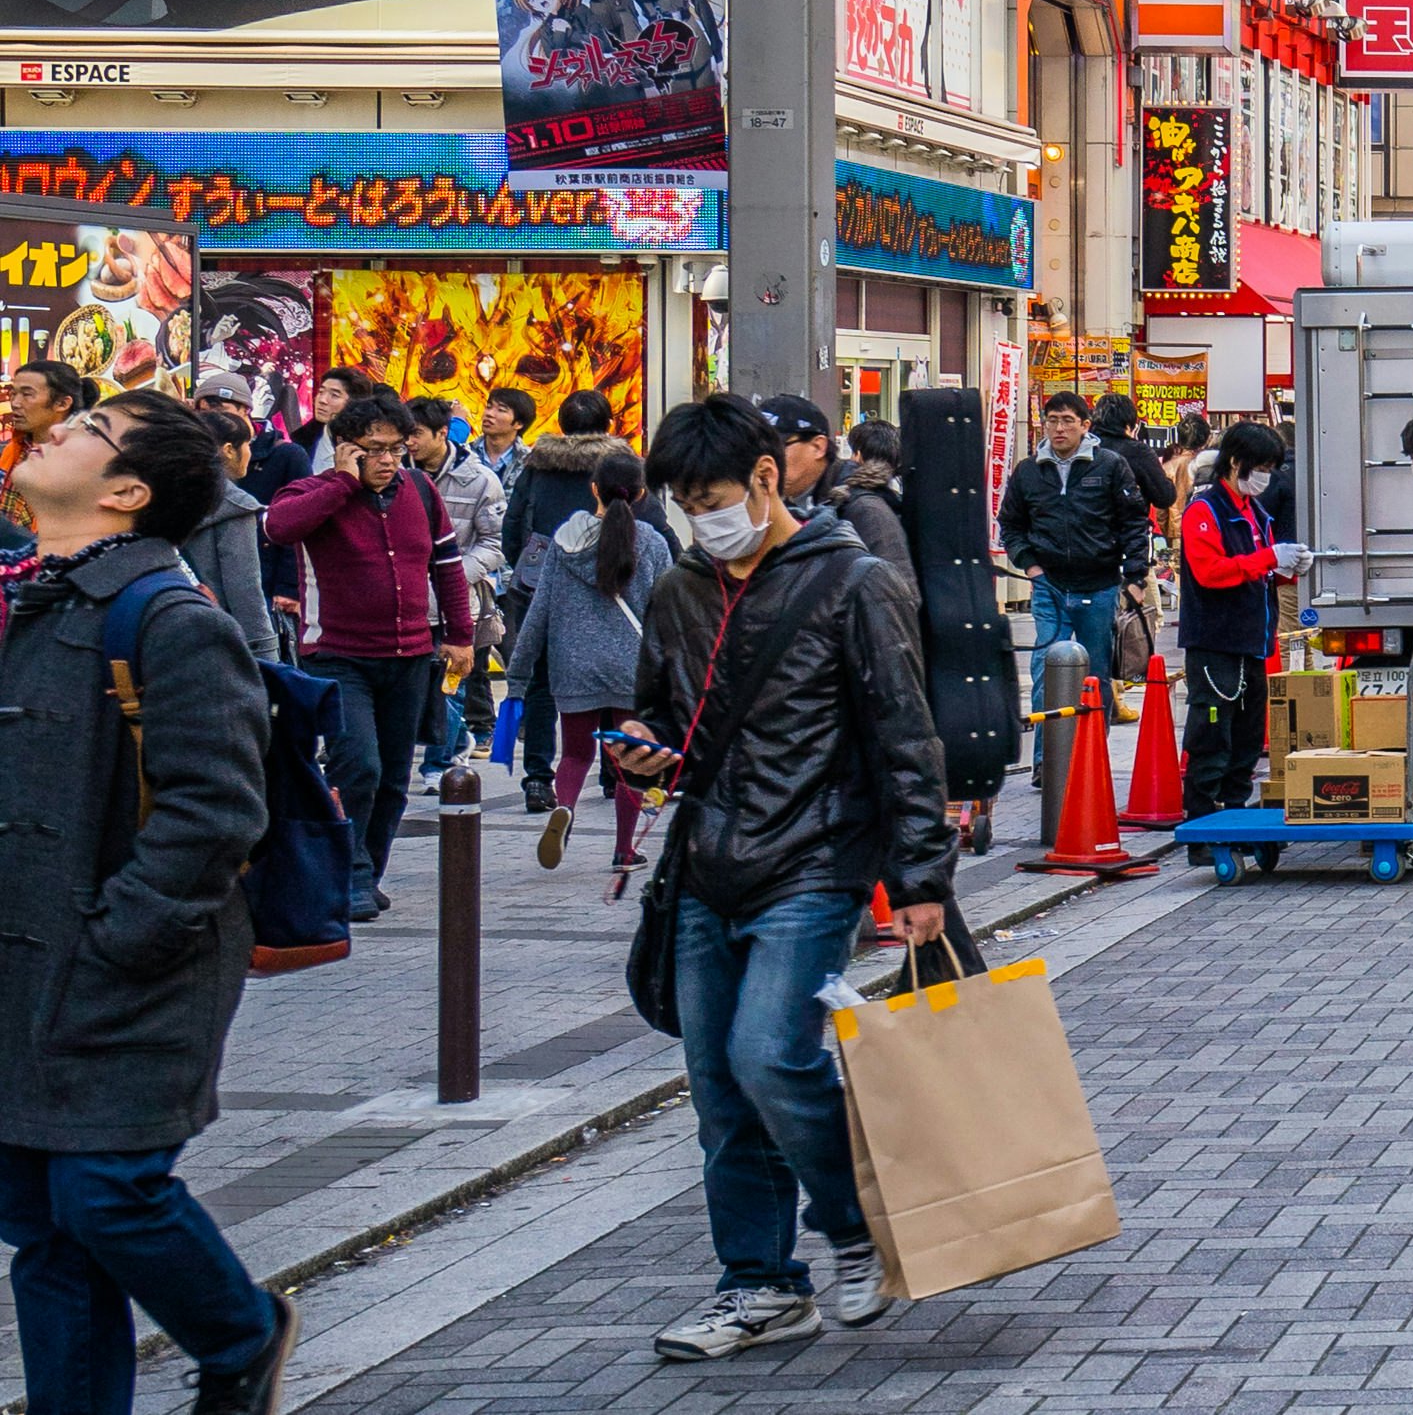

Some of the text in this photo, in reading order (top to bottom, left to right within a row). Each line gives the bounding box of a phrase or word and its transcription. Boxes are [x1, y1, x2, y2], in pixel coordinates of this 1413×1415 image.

[50, 64, 131, 84] ESPACE
[749, 117, 787, 129] 18-47
[905, 116, 925, 136] ESPACE
[519, 117, 595, 150] 1.10
[555, 171, 695, 187] 秋葉原駅前商店街振興組合
[1360, 670, 1383, 683] 足立
[1331, 794, 1352, 802] zero
